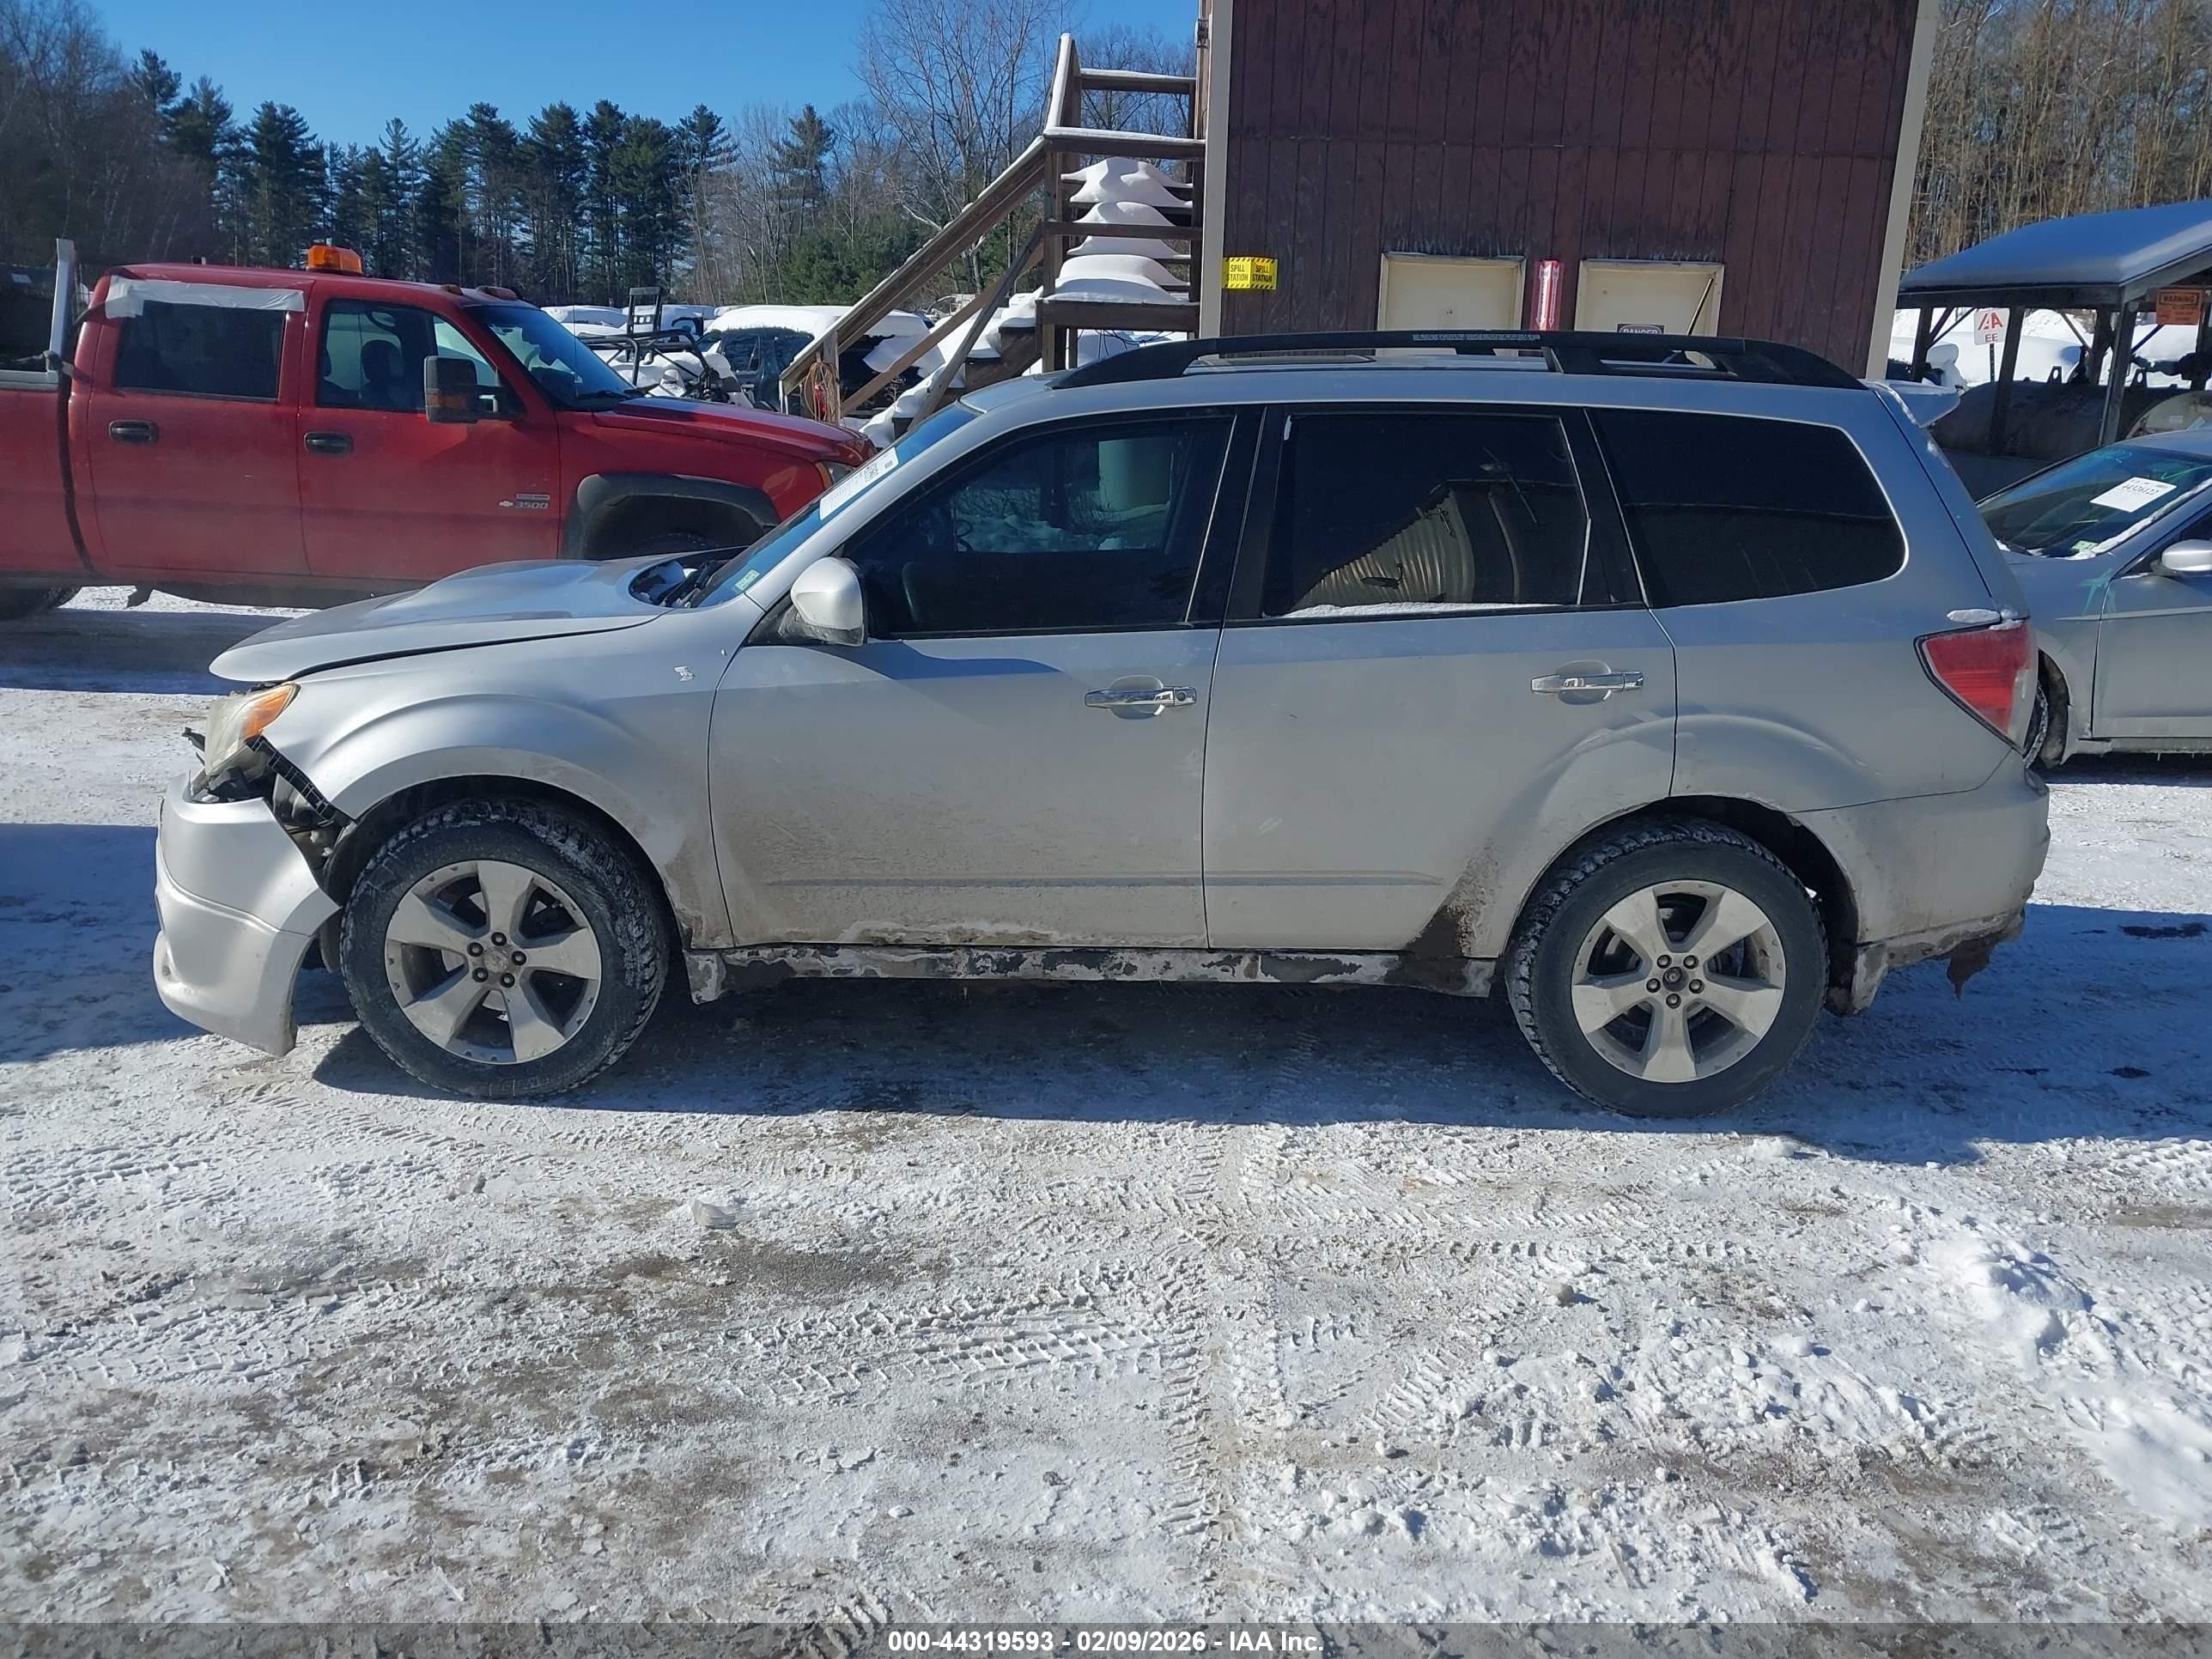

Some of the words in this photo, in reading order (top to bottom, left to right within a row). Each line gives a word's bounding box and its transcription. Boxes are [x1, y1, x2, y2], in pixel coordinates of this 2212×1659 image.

[1231, 264, 1245, 272] SPILL
[1226, 273, 1249, 282] STATION
[1252, 274, 1273, 283] STATION
[1985, 332, 1999, 343] EE
